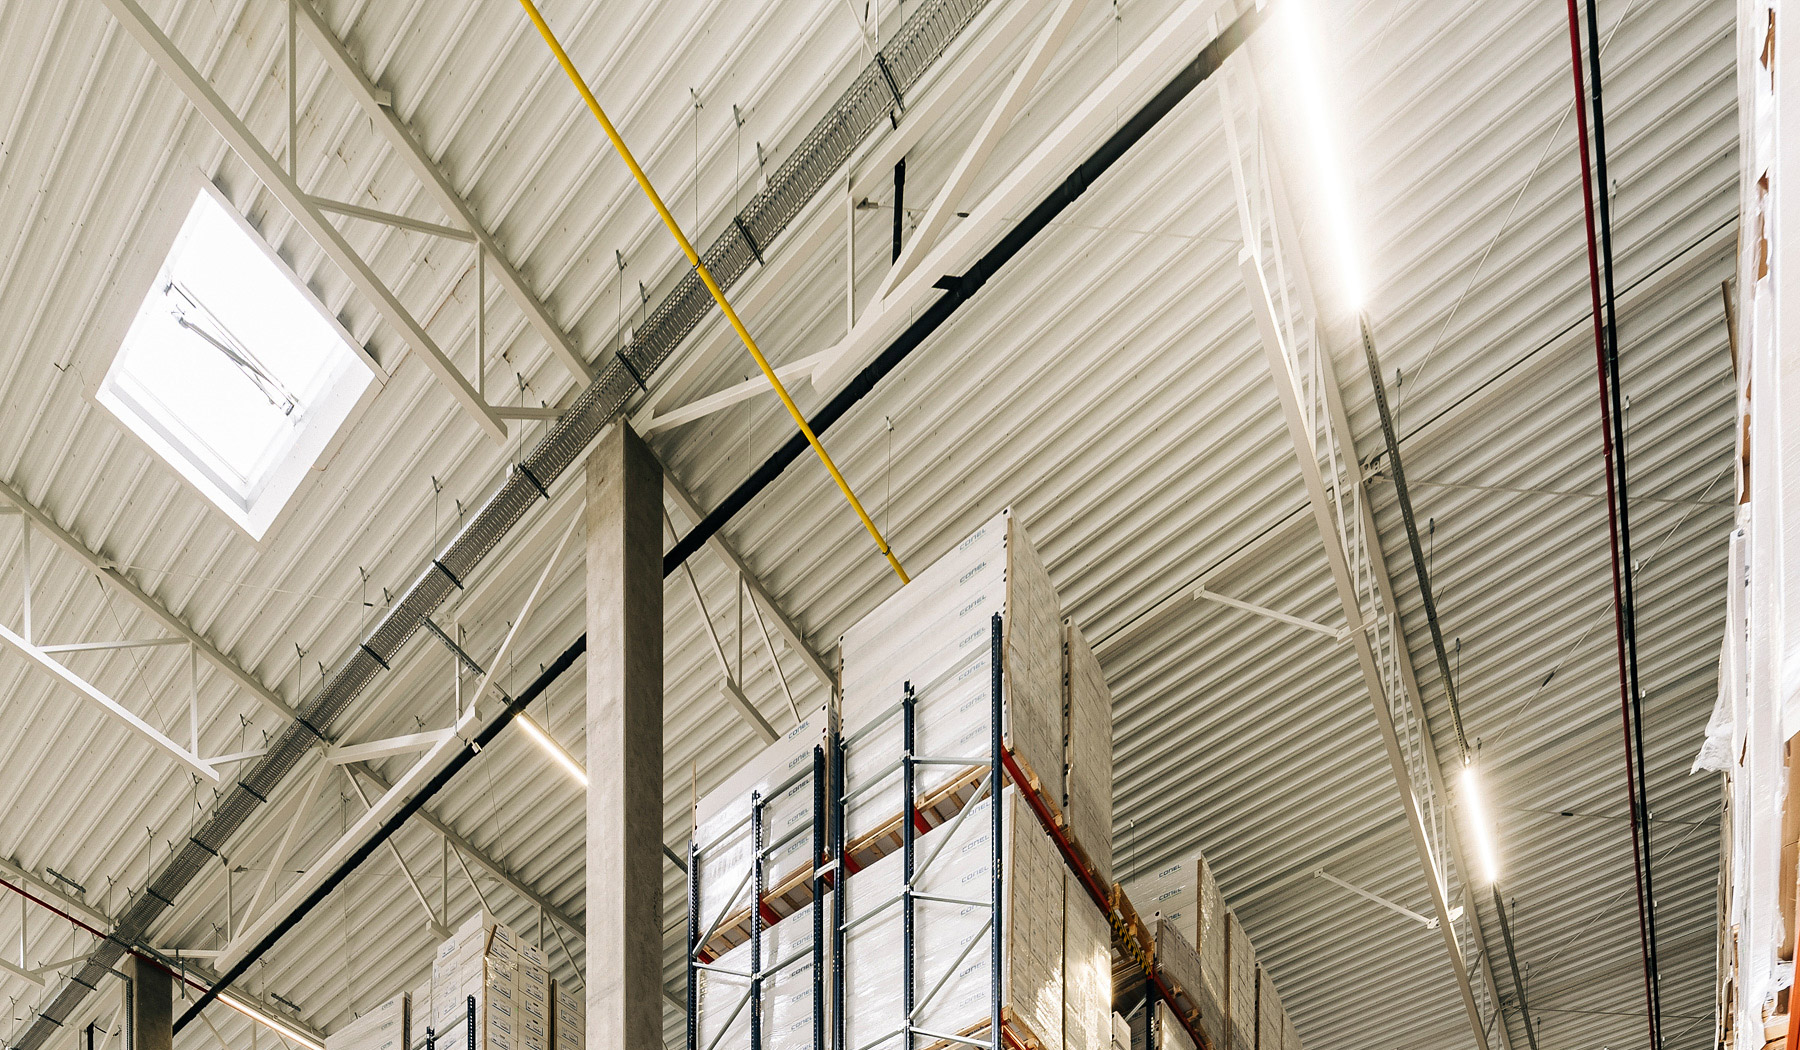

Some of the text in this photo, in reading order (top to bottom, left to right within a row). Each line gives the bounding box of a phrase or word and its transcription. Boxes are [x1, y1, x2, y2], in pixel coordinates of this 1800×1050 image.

[960, 528, 986, 550] CONEL
[960, 561, 986, 583] CONEL
[960, 594, 986, 616] CONEL
[959, 627, 986, 648] CONEL
[958, 660, 986, 681] CONEL
[960, 692, 987, 713] CONEL
[788, 721, 810, 740] CONEL
[960, 724, 987, 744] CONEL
[788, 750, 810, 769] CONEL
[788, 779, 810, 797] CONEL
[787, 808, 809, 825] CONEL
[965, 801, 991, 818] ONEL
[787, 838, 809, 854] CONEL
[962, 834, 990, 853] CONEL
[961, 866, 989, 884] CONEL
[1159, 865, 1181, 877] CONEL
[791, 962, 815, 977] CONEL
